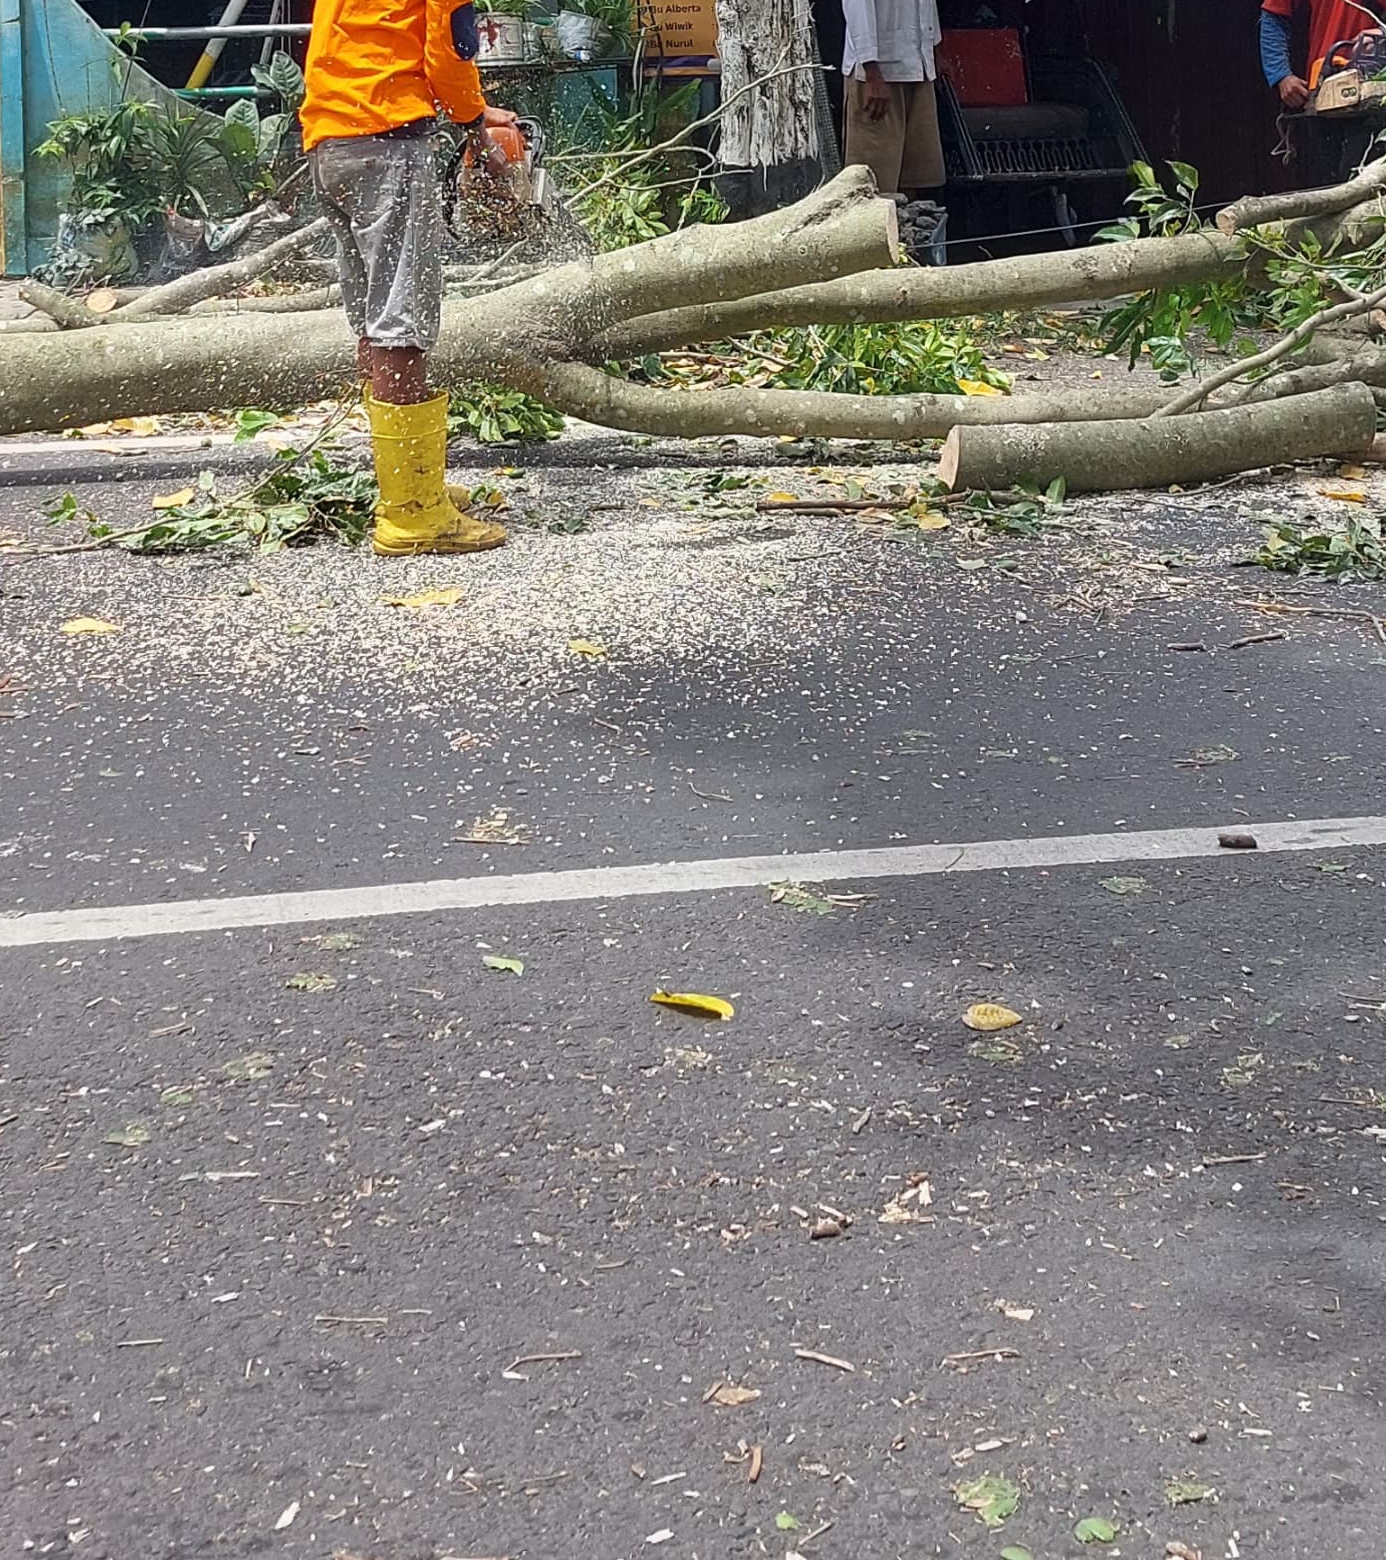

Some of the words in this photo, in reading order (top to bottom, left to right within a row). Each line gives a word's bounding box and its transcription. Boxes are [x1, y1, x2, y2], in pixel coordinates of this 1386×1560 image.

[665, 5, 701, 13] Alberta
[665, 22, 694, 31] Wiwik
[666, 40, 694, 48] Nurul
